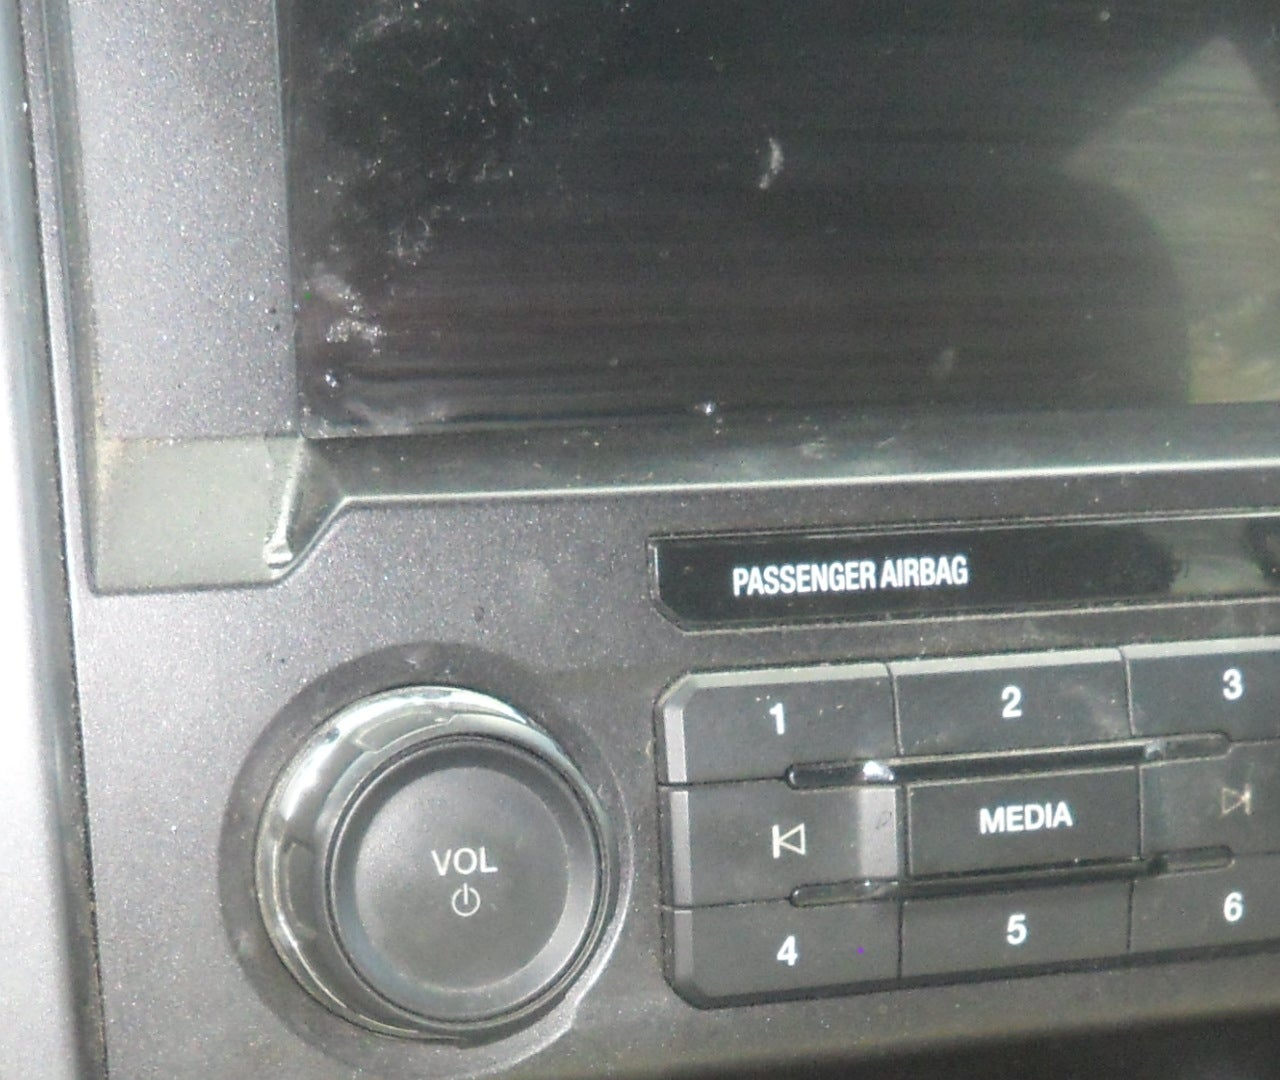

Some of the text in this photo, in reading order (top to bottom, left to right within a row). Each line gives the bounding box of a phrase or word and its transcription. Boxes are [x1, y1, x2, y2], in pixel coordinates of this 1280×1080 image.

[732, 554, 969, 597] PASSENGER AIRBAG
[1221, 669, 1244, 700] 3
[768, 702, 786, 735] 1
[1000, 686, 1023, 719] 2
[979, 801, 1073, 835] MEDIA
[431, 846, 499, 876] VOL
[1222, 891, 1244, 923] 6
[1006, 914, 1027, 945] 5
[776, 934, 799, 966] 4
